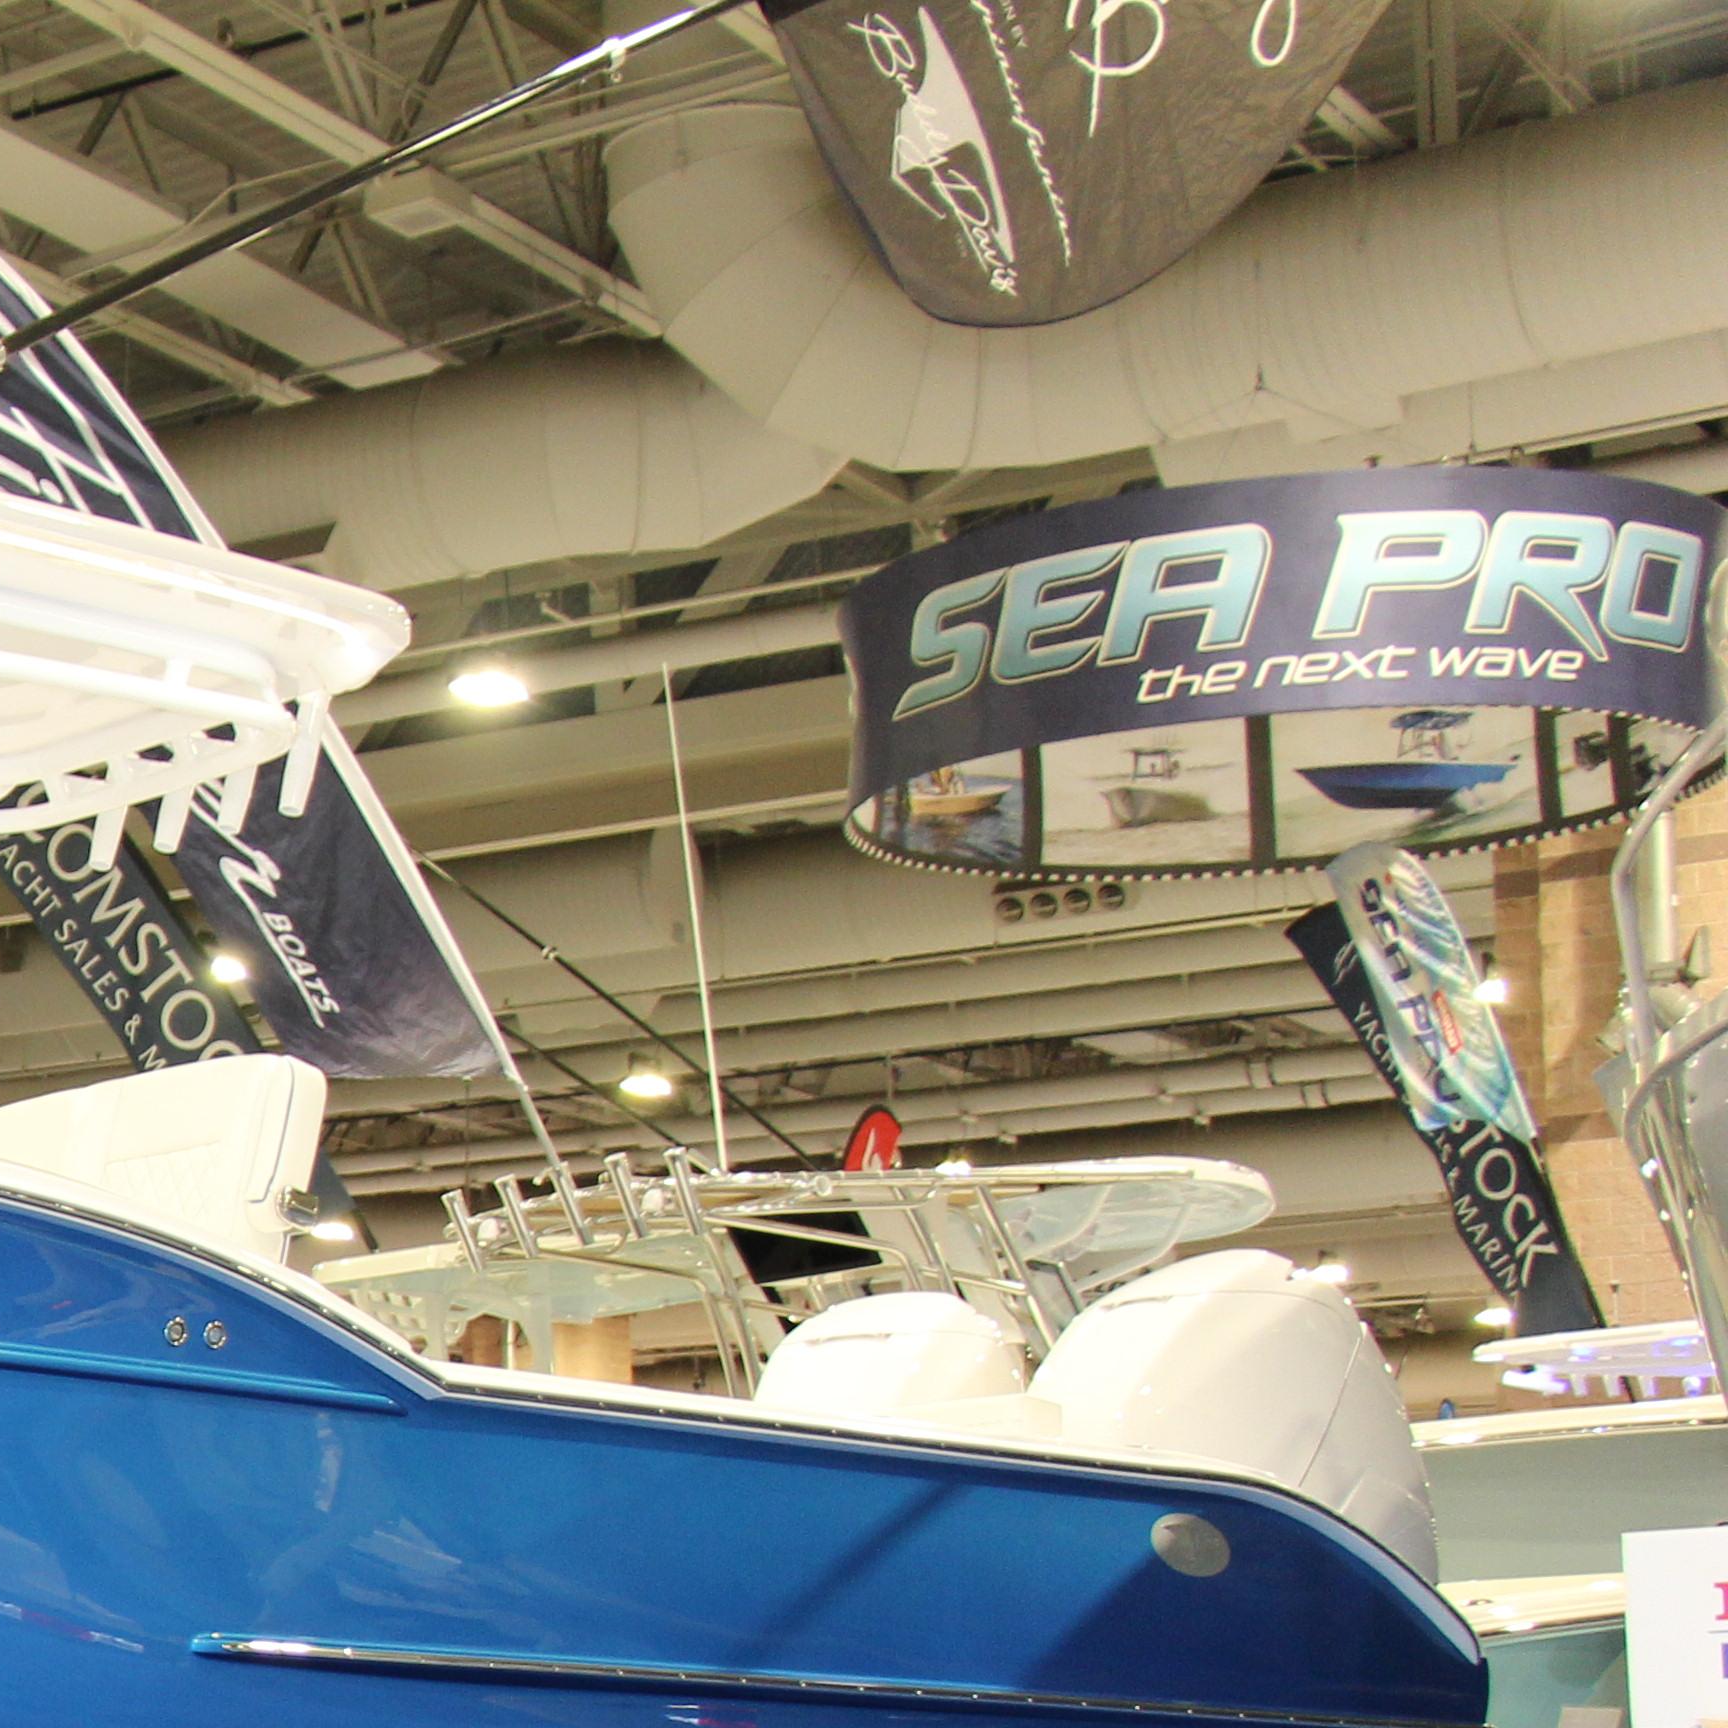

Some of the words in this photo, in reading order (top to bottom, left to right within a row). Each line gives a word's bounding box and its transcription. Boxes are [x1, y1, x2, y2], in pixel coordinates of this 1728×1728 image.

[932, 168, 1019, 296] Davis
[892, 523, 1273, 722] SEA
[1312, 510, 1704, 662] PRO
[1135, 659, 1247, 704] the
[1252, 645, 1417, 690] next
[1428, 646, 1584, 681] wave
[53, 918, 131, 1012] SALES
[124, 1012, 142, 1046] &
[262, 911, 341, 1014] BOATS
